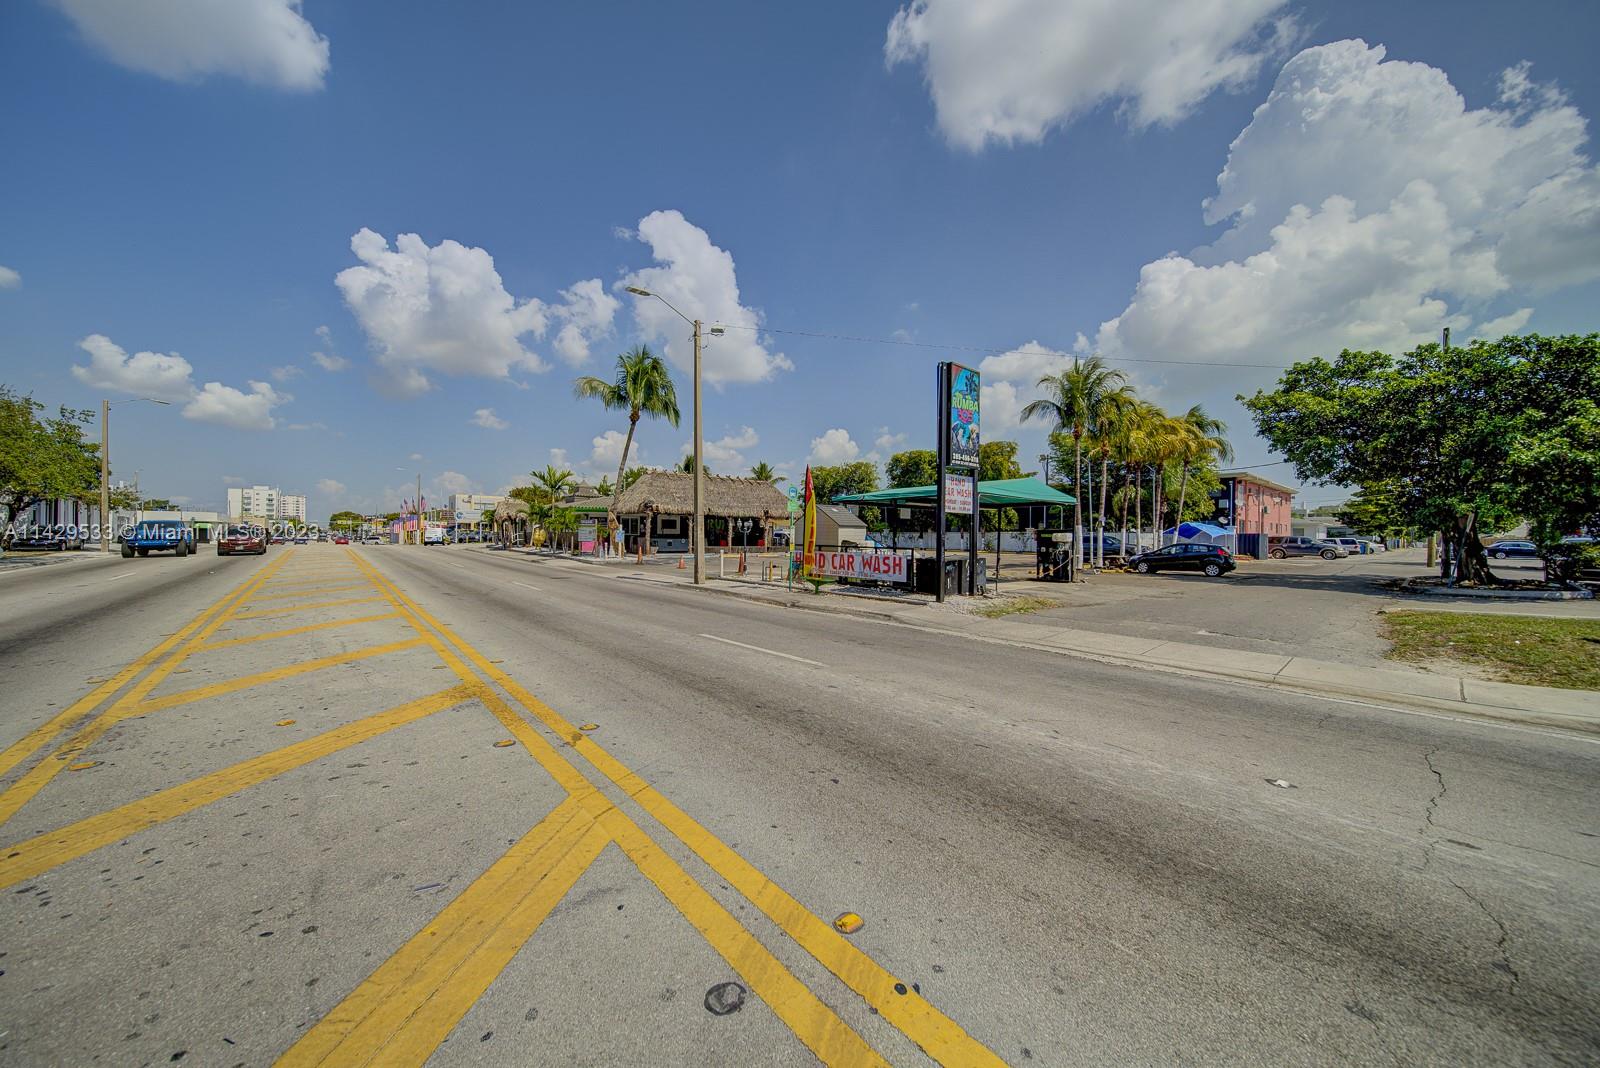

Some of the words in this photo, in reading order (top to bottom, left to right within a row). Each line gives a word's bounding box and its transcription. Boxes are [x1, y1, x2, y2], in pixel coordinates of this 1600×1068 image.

[952, 398, 979, 412] RUMBA
[957, 489, 971, 498] WASH
[831, 553, 855, 571] CAR
[862, 555, 902, 575] WASH
